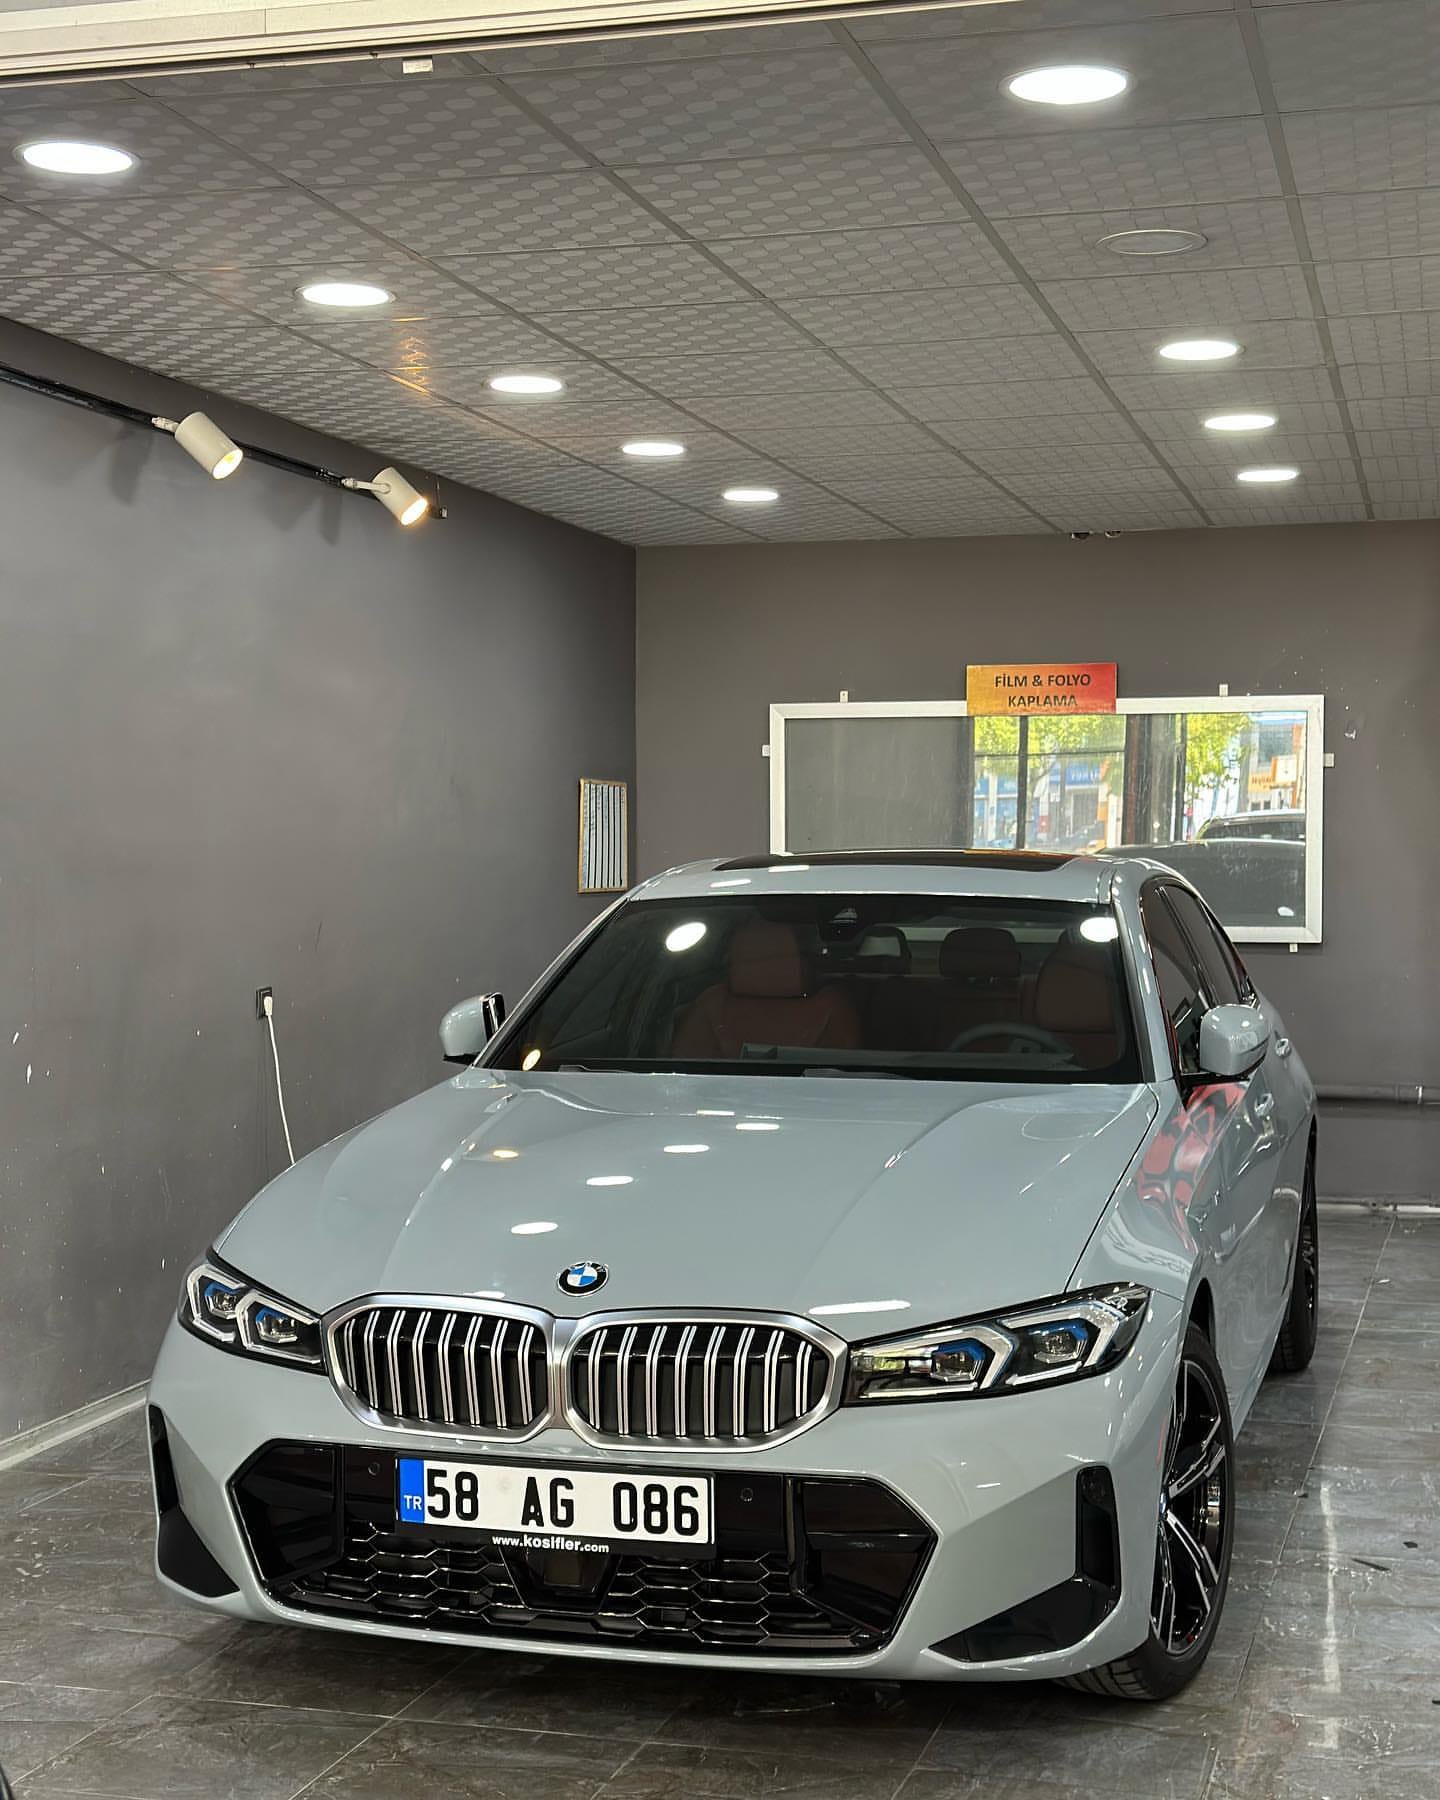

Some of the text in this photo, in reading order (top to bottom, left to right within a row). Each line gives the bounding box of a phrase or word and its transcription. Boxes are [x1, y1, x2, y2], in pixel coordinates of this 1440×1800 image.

[994, 673, 1092, 688] FİLM & FOLYO
[1007, 694, 1078, 708] KAPLAMA
[403, 1494, 423, 1511] TR
[426, 1468, 700, 1537] 58 AG 086
[491, 1533, 610, 1553] www.kosifler.com
